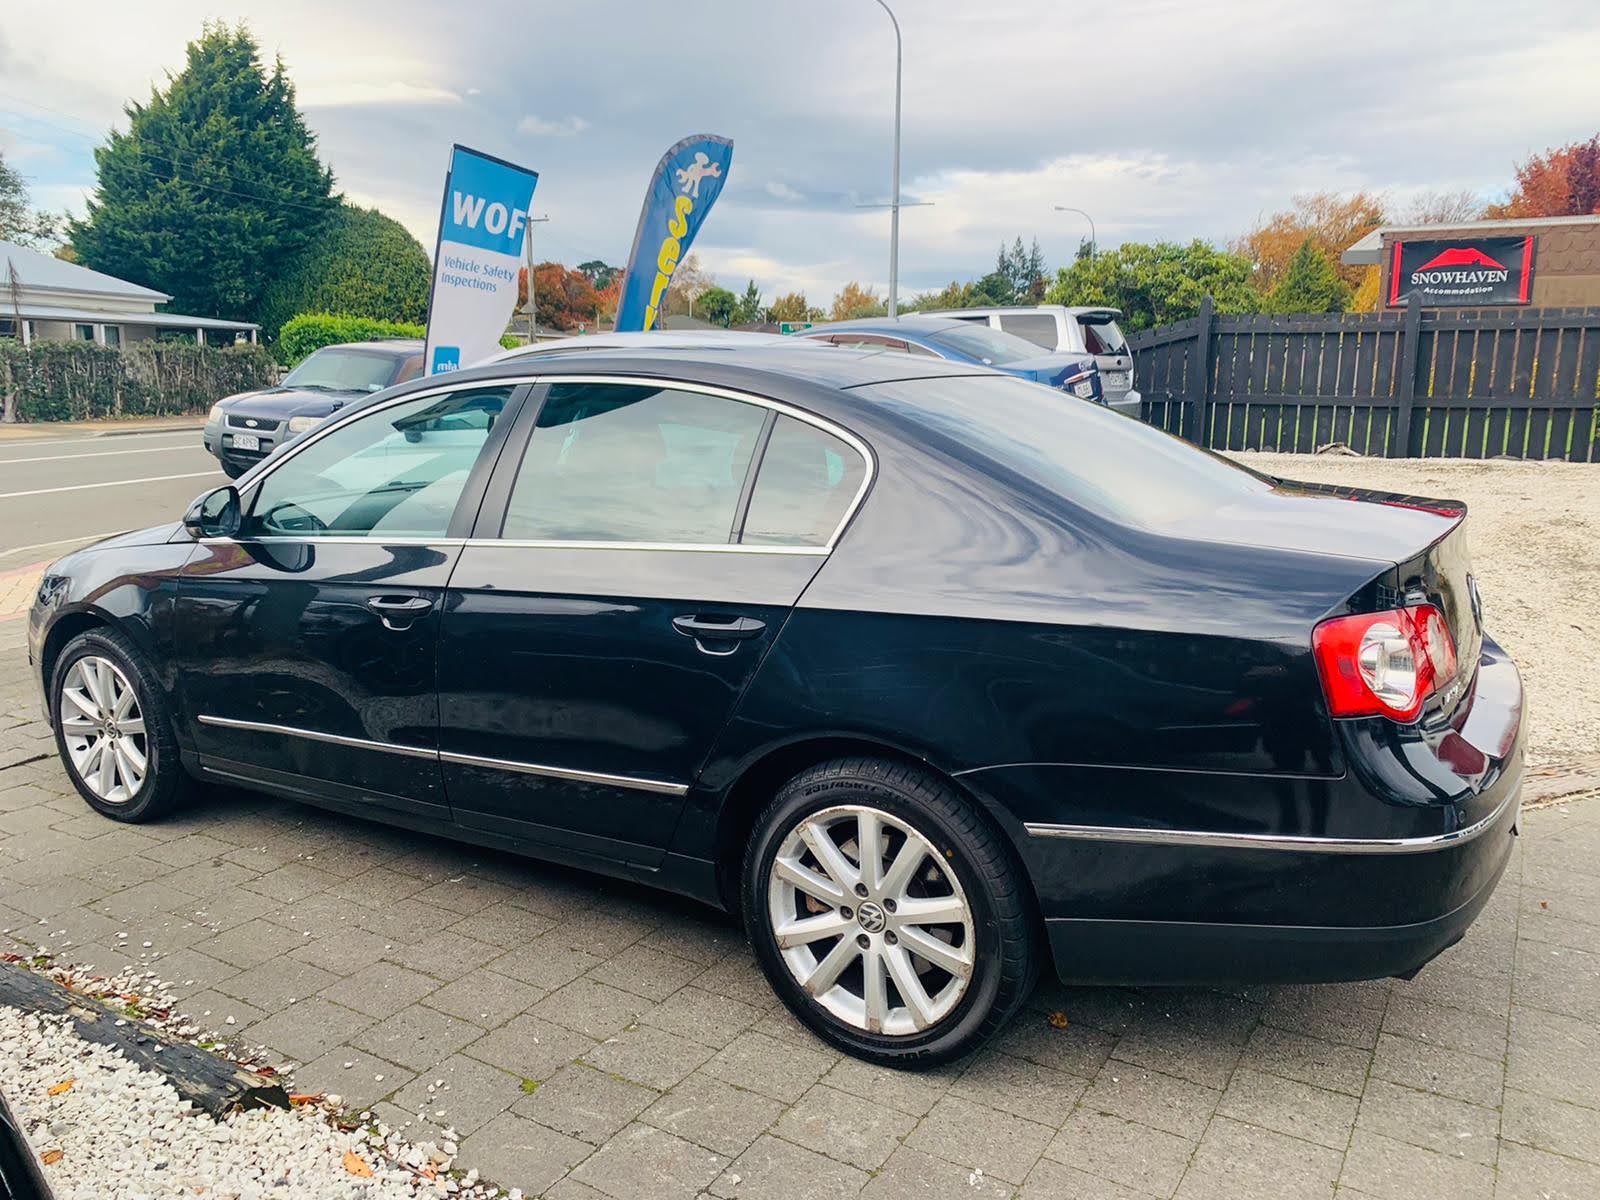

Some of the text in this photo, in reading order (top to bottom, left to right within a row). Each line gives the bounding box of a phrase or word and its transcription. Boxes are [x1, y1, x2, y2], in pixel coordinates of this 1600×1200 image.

[453, 191, 527, 240] WOF
[444, 255, 515, 282] Vehicle Safety
[1410, 270, 1509, 285] SNOWHAVEN
[441, 272, 497, 293] Inspections
[1423, 286, 1493, 295] Accommodation
